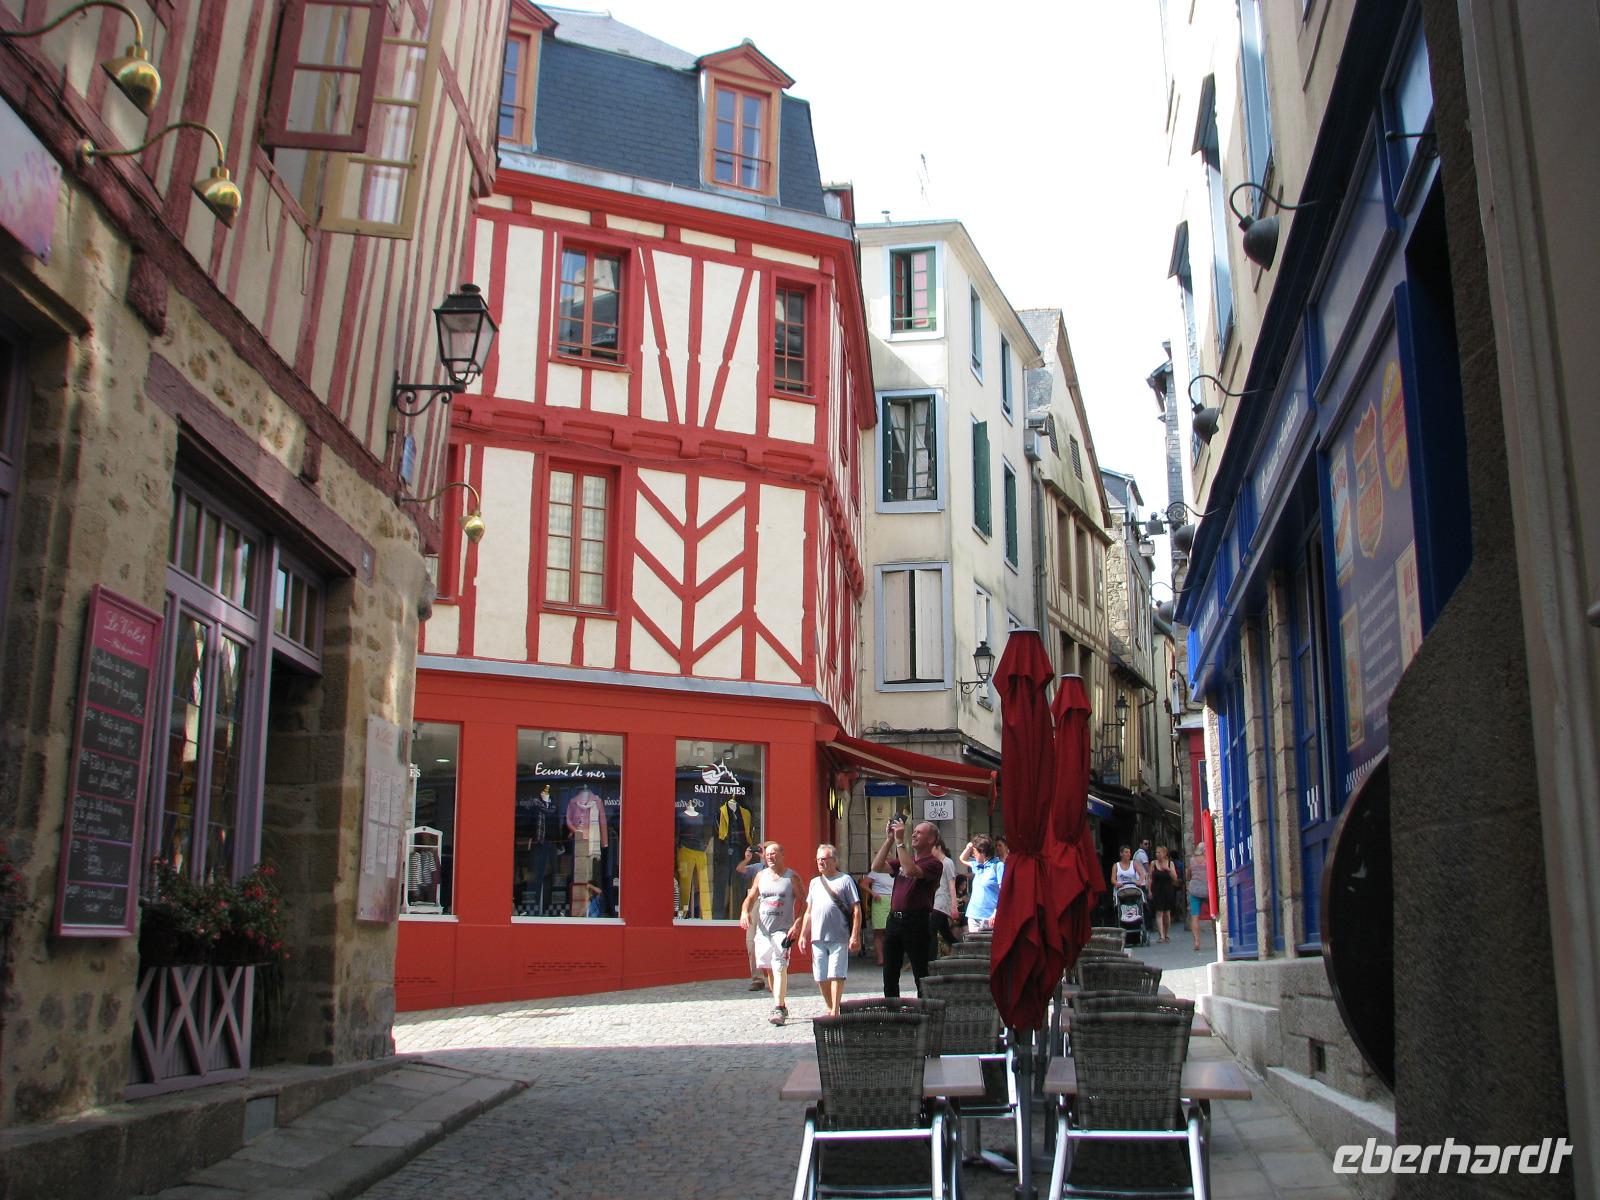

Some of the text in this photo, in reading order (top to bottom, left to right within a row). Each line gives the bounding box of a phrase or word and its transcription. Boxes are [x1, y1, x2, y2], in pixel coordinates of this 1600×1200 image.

[534, 761, 606, 779] Ecume de mer
[694, 784, 746, 796] SAINT JAMES
